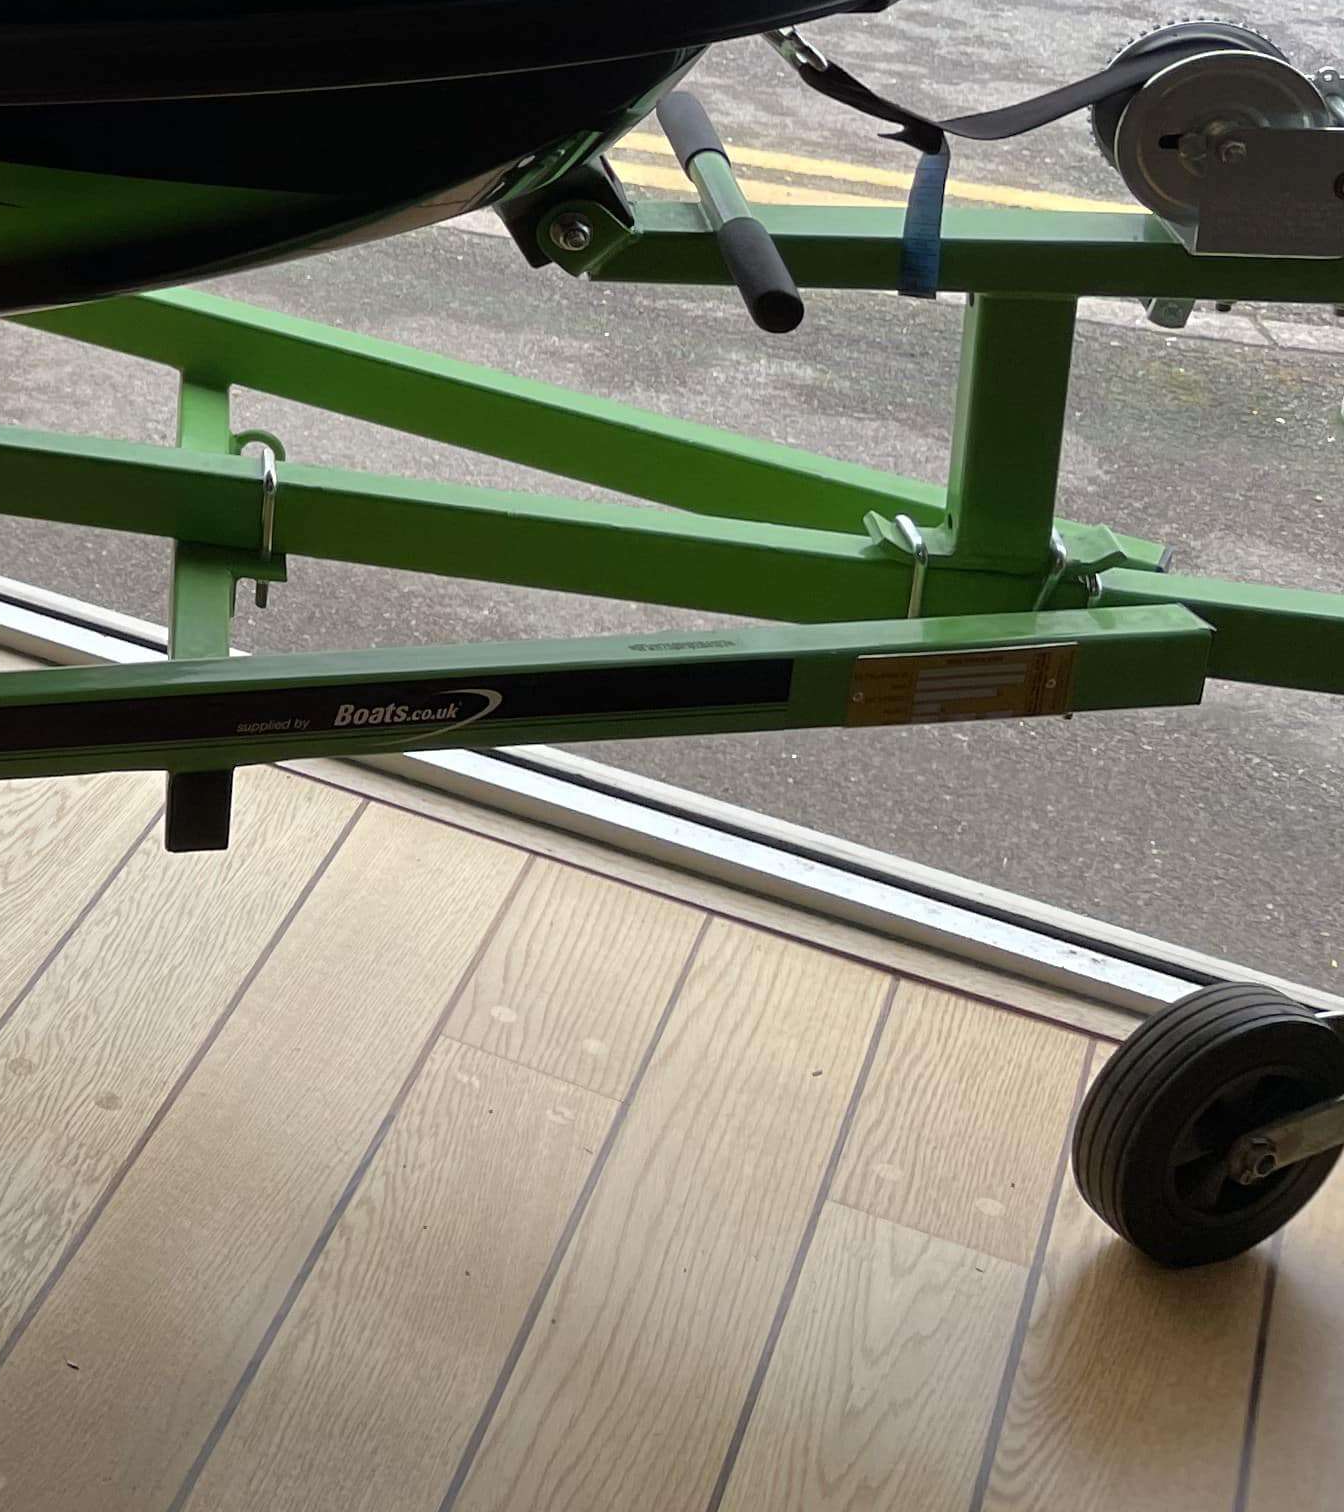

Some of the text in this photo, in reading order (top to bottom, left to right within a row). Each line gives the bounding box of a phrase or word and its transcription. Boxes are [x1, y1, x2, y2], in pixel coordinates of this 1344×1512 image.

[236, 701, 459, 735] supplied by Boats.co.uk
